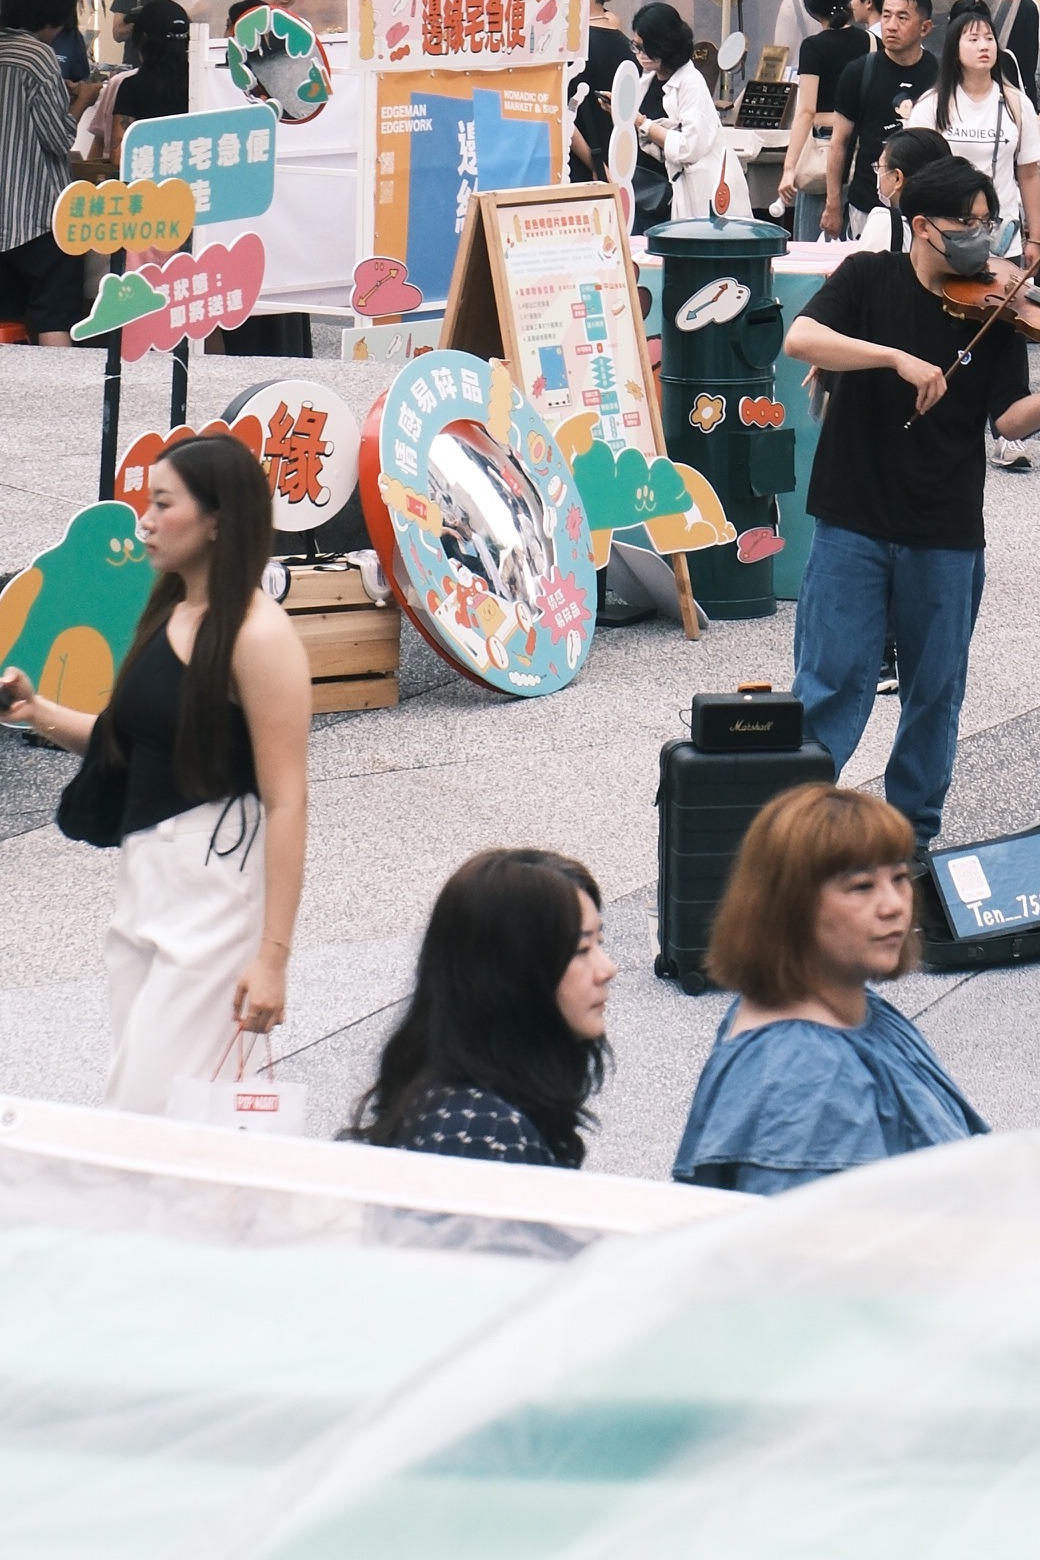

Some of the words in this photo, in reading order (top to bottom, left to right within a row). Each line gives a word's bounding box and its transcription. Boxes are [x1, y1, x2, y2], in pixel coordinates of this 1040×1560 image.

[537, 93, 549, 103] OF
[380, 104, 427, 120] EDGEMAN
[503, 101, 533, 113] MARKET
[380, 119, 433, 134] EDGEWORK
[130, 128, 271, 180] 邊緣宅急便
[68, 193, 145, 218] 邊緣工事
[67, 220, 181, 243] EDGEWORK
[729, 718, 774, 732] Marshall
